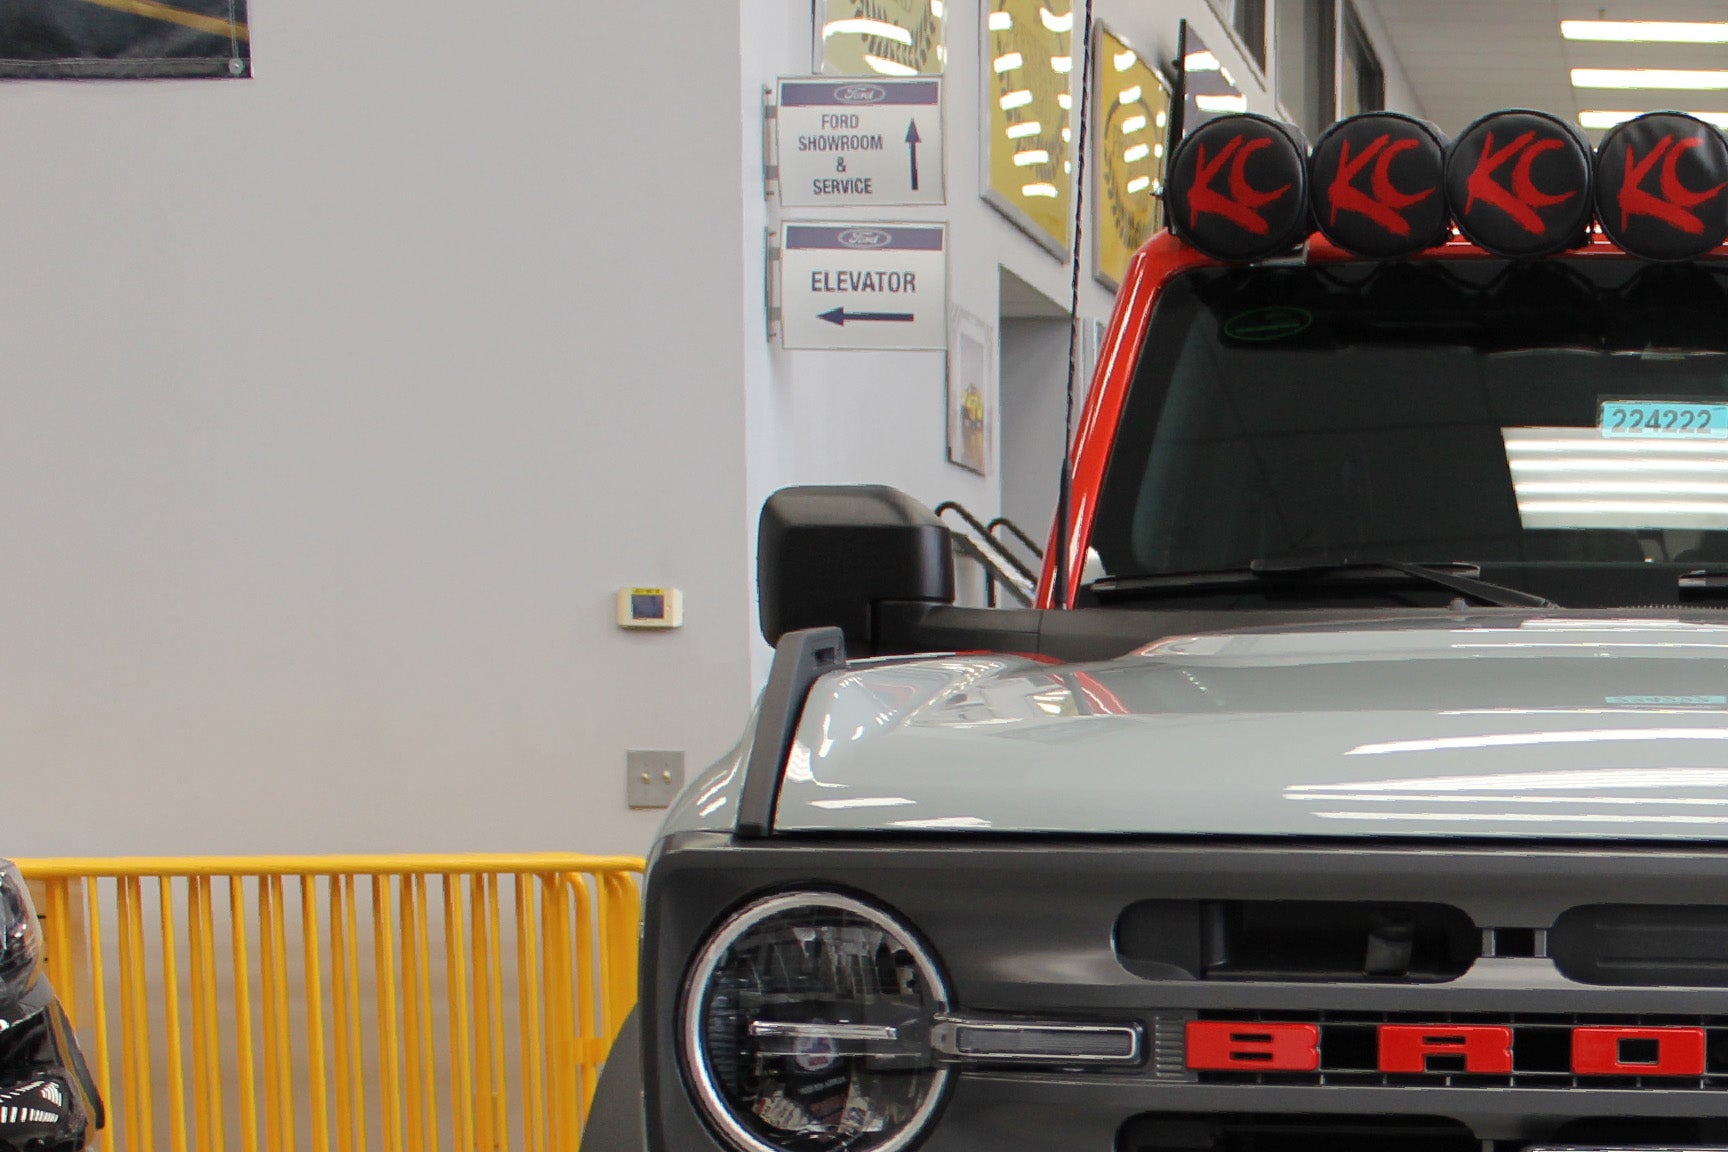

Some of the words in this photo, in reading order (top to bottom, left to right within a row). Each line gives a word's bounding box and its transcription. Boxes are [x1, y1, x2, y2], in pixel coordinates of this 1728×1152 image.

[821, 114, 859, 129] FORD
[798, 134, 883, 151] SHOWROOM
[836, 156, 847, 173] &
[813, 178, 873, 195] SERVICE
[1187, 134, 1291, 235] KC
[1328, 133, 1436, 237] KC
[1465, 129, 1577, 235] KC
[1617, 133, 1728, 234] KC
[811, 271, 916, 292] ELEVATOR
[1611, 408, 1712, 434] 224222
